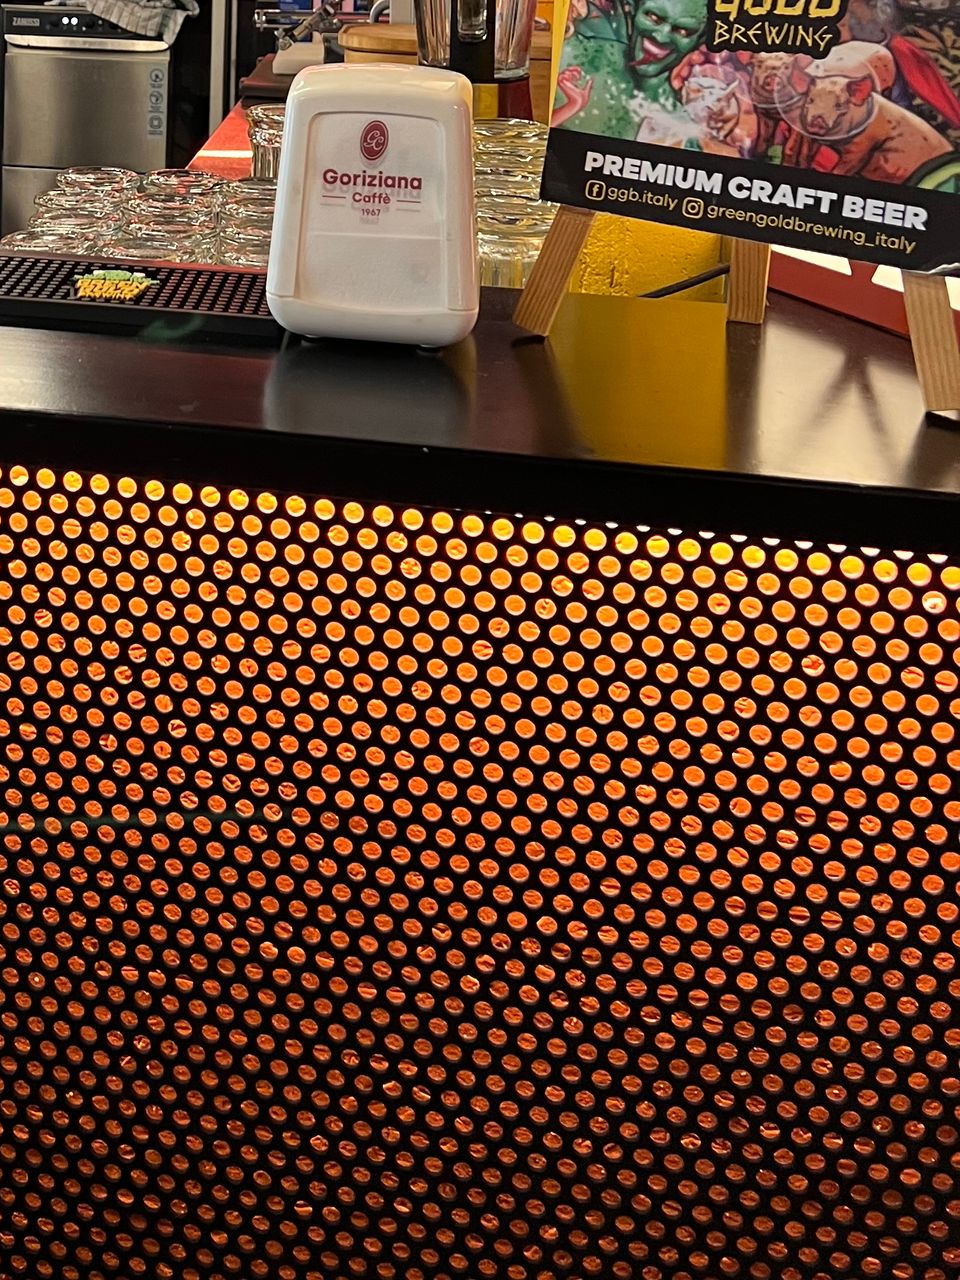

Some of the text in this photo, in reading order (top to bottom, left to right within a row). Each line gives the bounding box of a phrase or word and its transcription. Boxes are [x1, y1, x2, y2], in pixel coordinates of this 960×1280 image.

[713, 20, 833, 51] BREWING
[323, 168, 423, 190] Goriziana
[584, 151, 929, 232] PREMIUM CRAFT BEER
[352, 192, 392, 205] Caffè
[607, 186, 679, 211] ggb.italy
[361, 208, 382, 217] 1967
[707, 203, 917, 255] greengoldbrewing_italy
